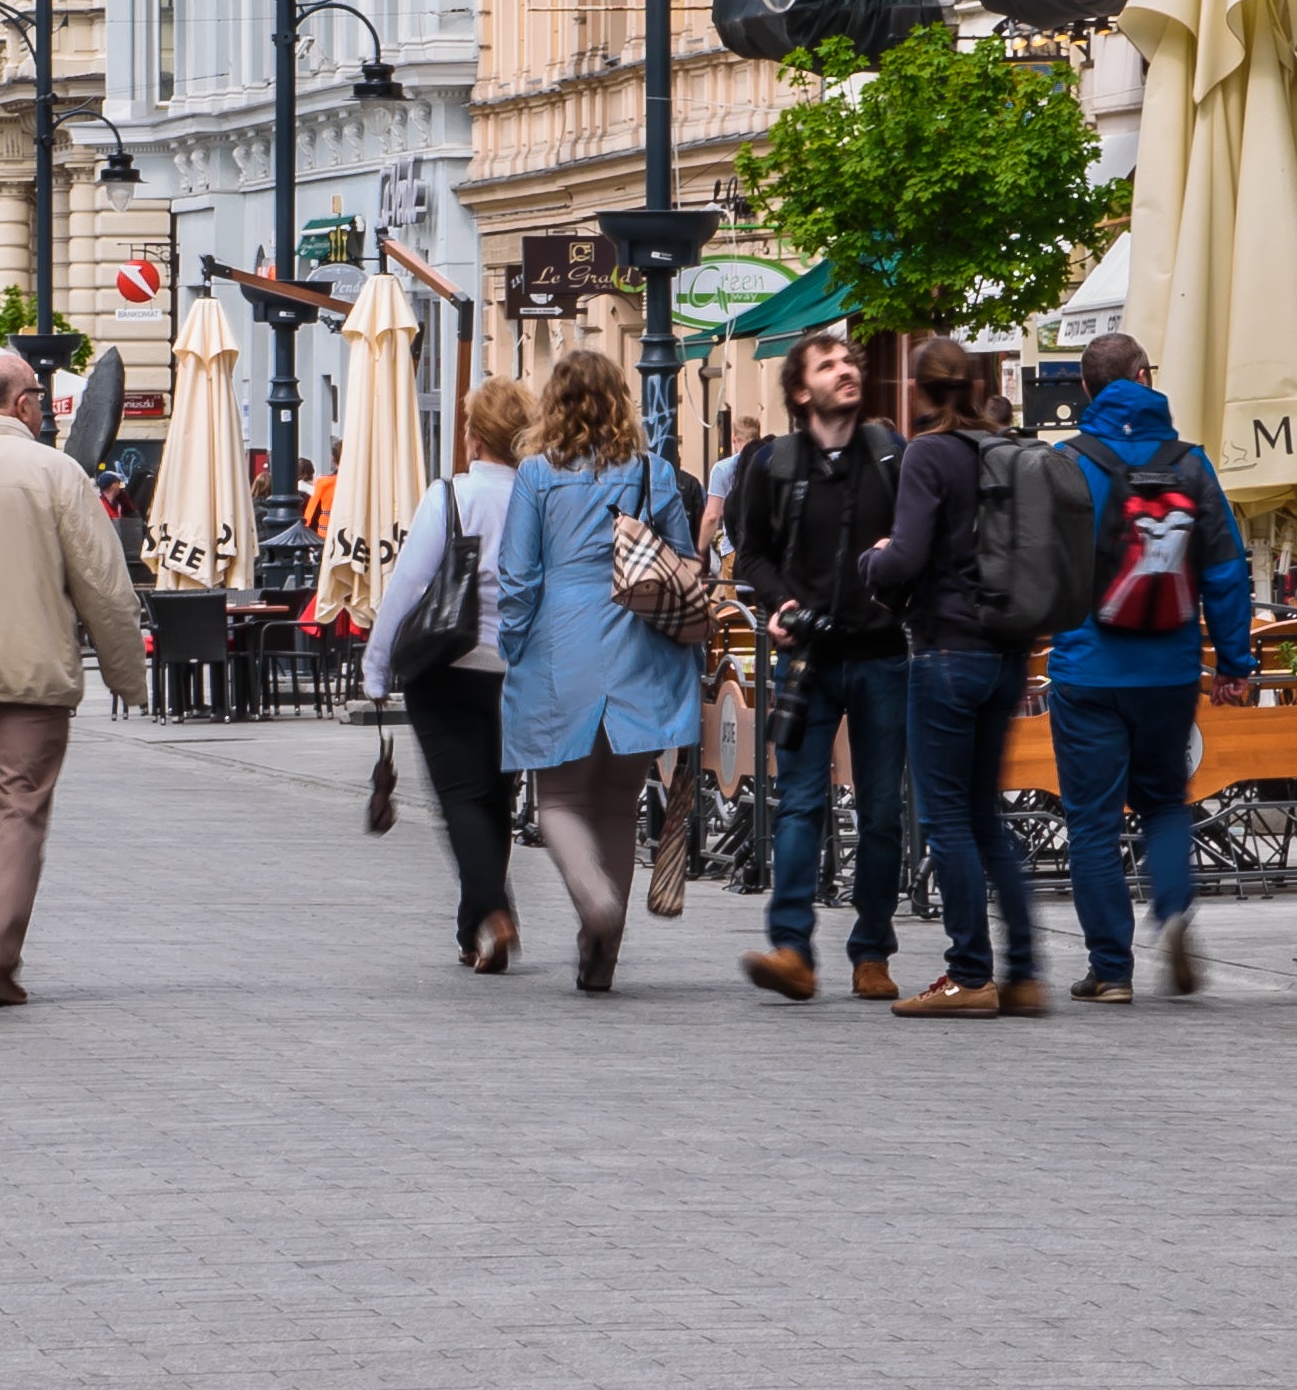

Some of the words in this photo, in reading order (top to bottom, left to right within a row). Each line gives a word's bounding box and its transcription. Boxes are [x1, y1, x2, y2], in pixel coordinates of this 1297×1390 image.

[531, 265, 561, 285] Le
[688, 265, 766, 314] Green
[731, 292, 758, 303] way
